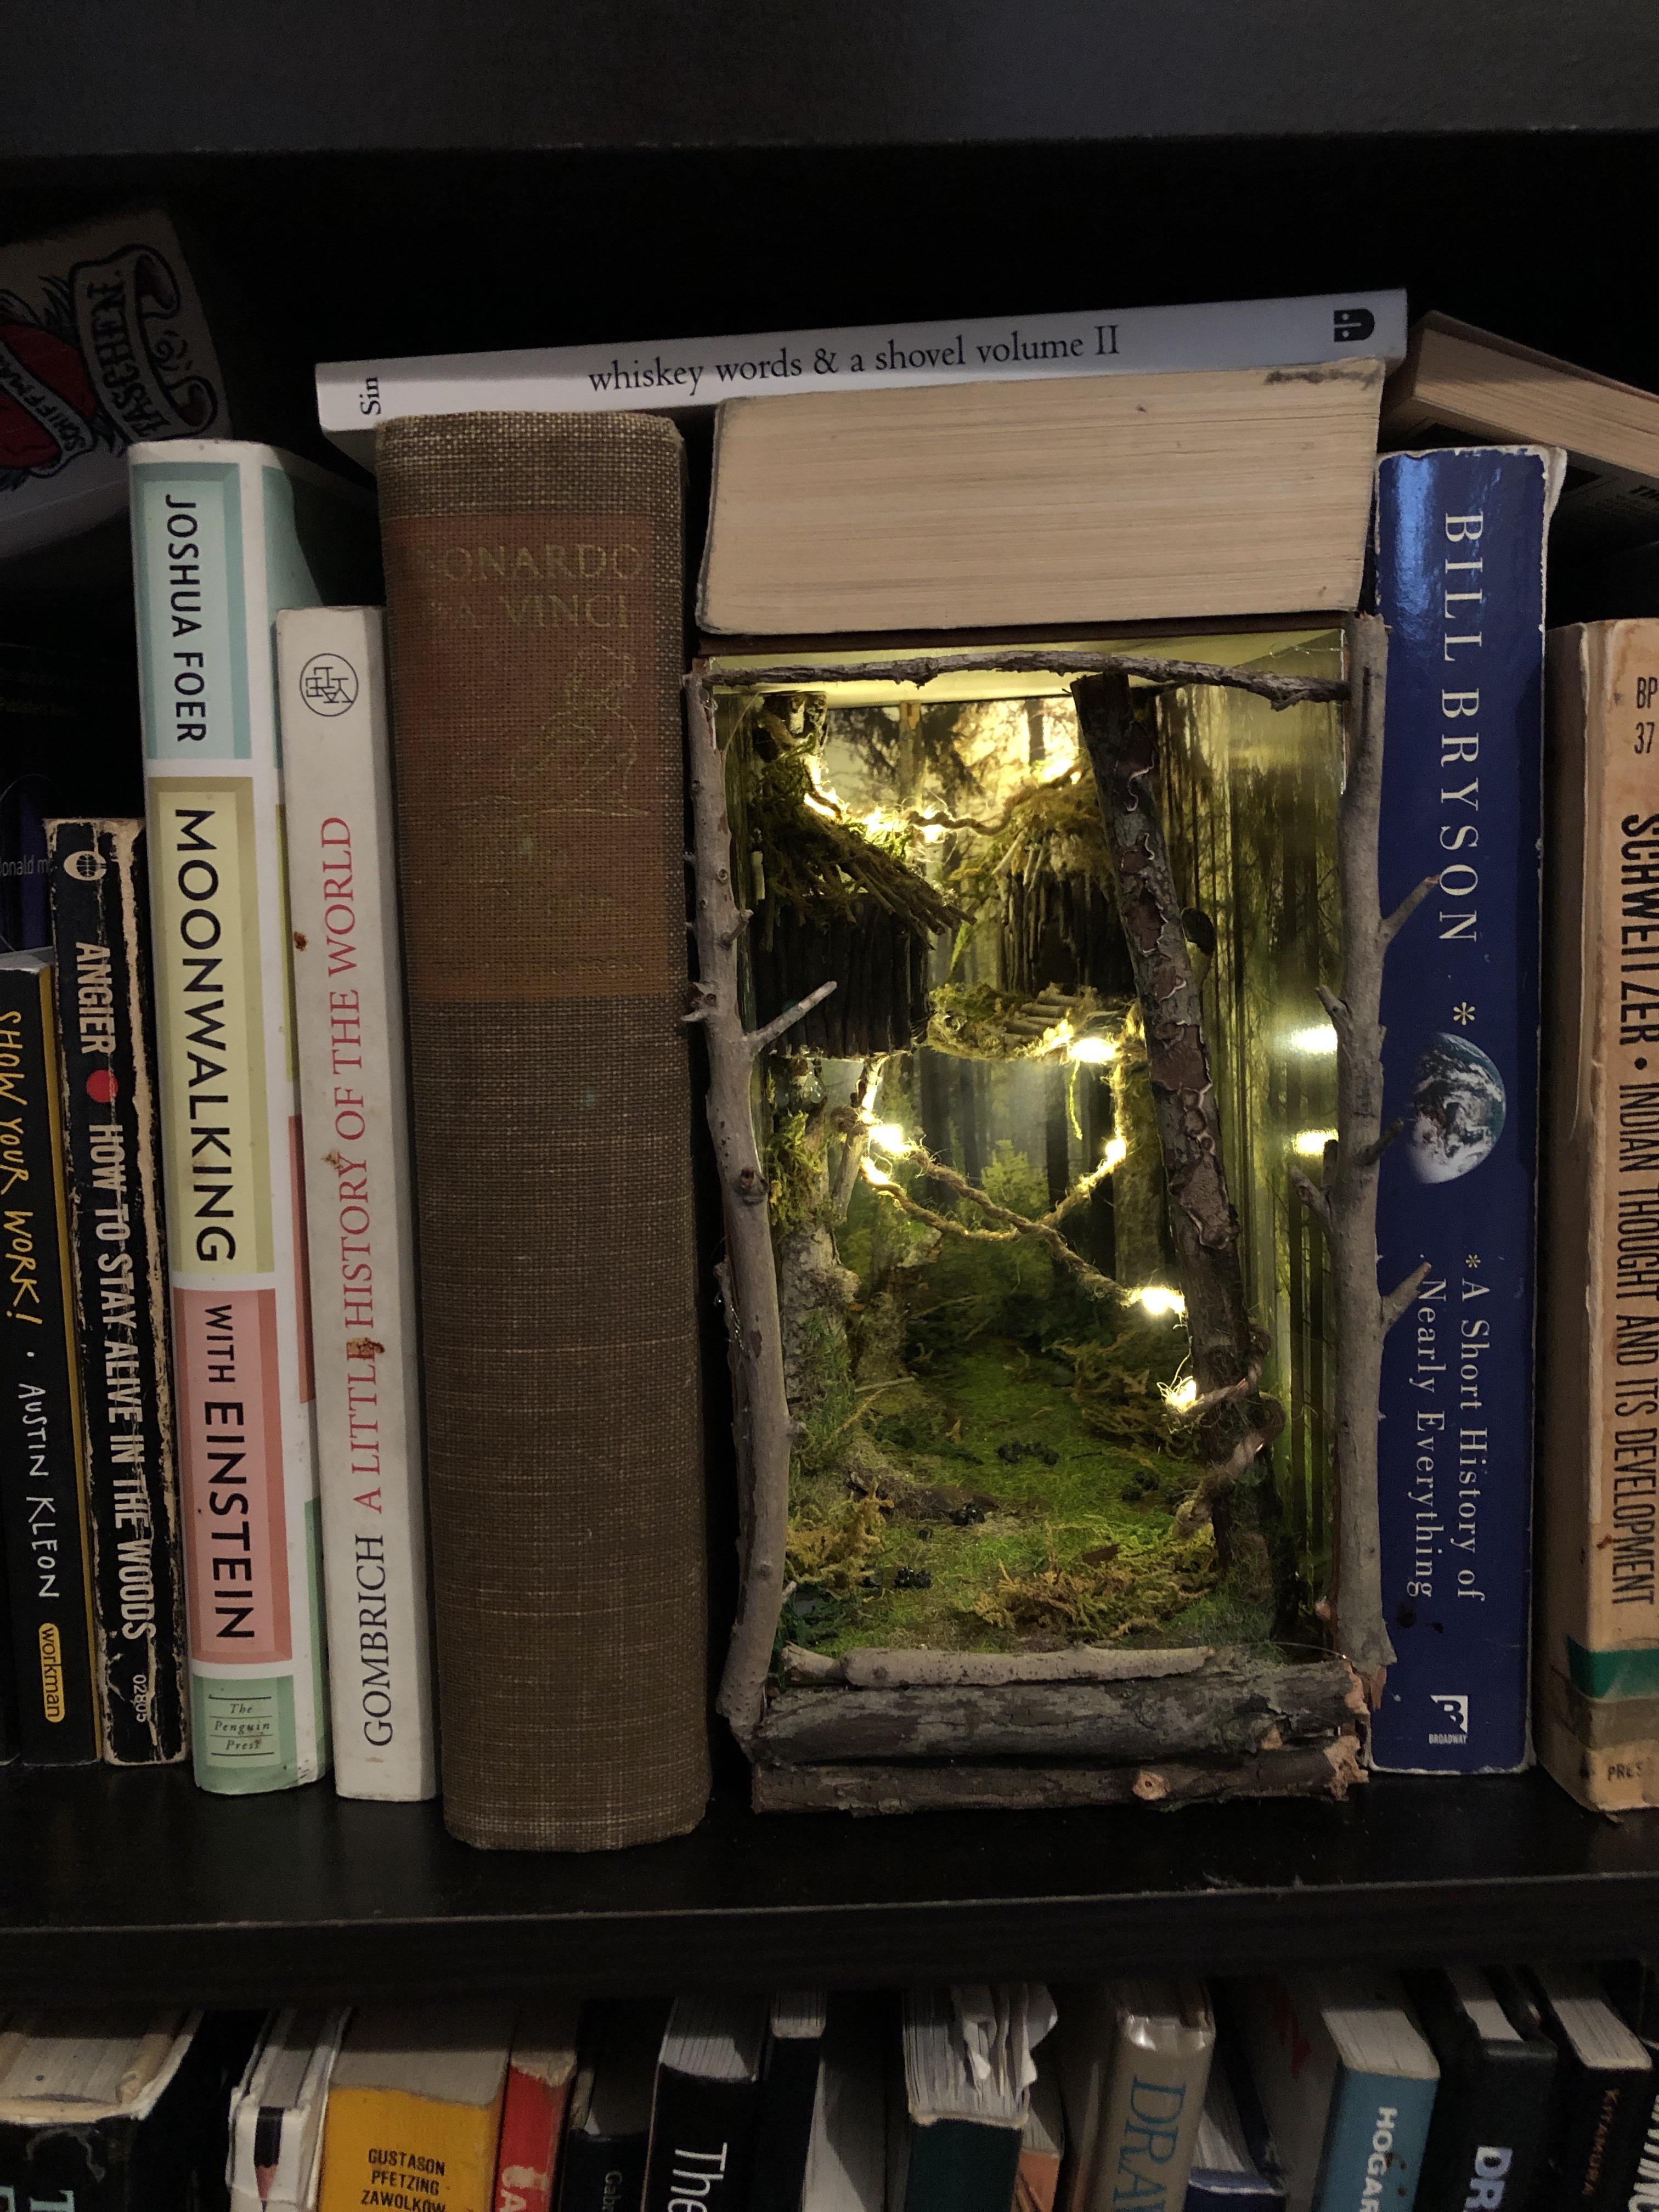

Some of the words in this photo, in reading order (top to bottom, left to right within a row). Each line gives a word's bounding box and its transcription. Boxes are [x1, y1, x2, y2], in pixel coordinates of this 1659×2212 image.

[359, 377, 381, 415] Sin
[589, 357, 704, 396] whiskey
[715, 347, 803, 383] words
[814, 350, 840, 375] &
[850, 354, 865, 373] a
[876, 335, 966, 373] shovel
[977, 330, 1084, 365] volume
[1096, 325, 1120, 356] II
[166, 494, 202, 637] JOSHUA
[1444, 512, 1484, 662] BILL
[500, 594, 629, 628] VINCI
[173, 652, 207, 742] FOER
[1636, 676, 1658, 709] BP
[1634, 721, 1655, 754] 37
[1438, 688, 1480, 942] BRYSON
[0, 853, 35, 877] onald
[321, 817, 358, 978] WORLD
[76, 941, 115, 1056] ANGIER
[174, 809, 236, 1262] MOONWALKING
[331, 989, 363, 1074] THE
[0, 1011, 27, 1105] SHOW
[334, 1086, 366, 1140] OF
[1618, 1082, 1659, 1173] INDIAN
[0, 1118, 29, 1195] YOUR
[88, 1124, 127, 1193] HOW
[95, 1209, 131, 1243] TO
[337, 1154, 374, 1329] HISTORY
[1616, 1182, 1659, 1301] THOUGHT
[3, 1210, 43, 1324] WORK!
[96, 1252, 138, 1330] STAY
[1461, 1278, 1491, 1302] A
[205, 1304, 235, 1384] WITH
[1409, 1278, 1447, 1394] Nearly
[1460, 1319, 1491, 1412] Short
[1615, 1313, 1659, 1367] AND
[104, 1340, 144, 1424] ALIVE
[346, 1341, 380, 1475] LITTLE
[1615, 1378, 1658, 1418] ITS
[18, 1382, 49, 1478] AUSTIN
[110, 1434, 145, 1464] IN
[110, 1473, 150, 1530] THE
[205, 1401, 255, 1639] EINSTEIN
[352, 1486, 382, 1514] A
[1406, 1410, 1446, 1599] Everything
[1451, 1427, 1488, 1554] History
[1612, 1427, 1658, 1605] DEVELOPMENT
[26, 1496, 60, 1599] KLEON
[1457, 1568, 1486, 1602] of
[116, 1538, 156, 1641] WOODS
[41, 1627, 61, 1718] workman
[354, 1533, 393, 1747] GOMBRICH
[132, 1674, 148, 1723] 02805
[215, 1720, 270, 1735] Penguin
[229, 1703, 253, 1714] The
[225, 1739, 261, 1751] Press
[1429, 1734, 1467, 1744] BROADWAY
[368, 2148, 446, 2177] GUSTASON
[371, 2170, 439, 2196] PFETZING
[668, 2142, 727, 2212] The
